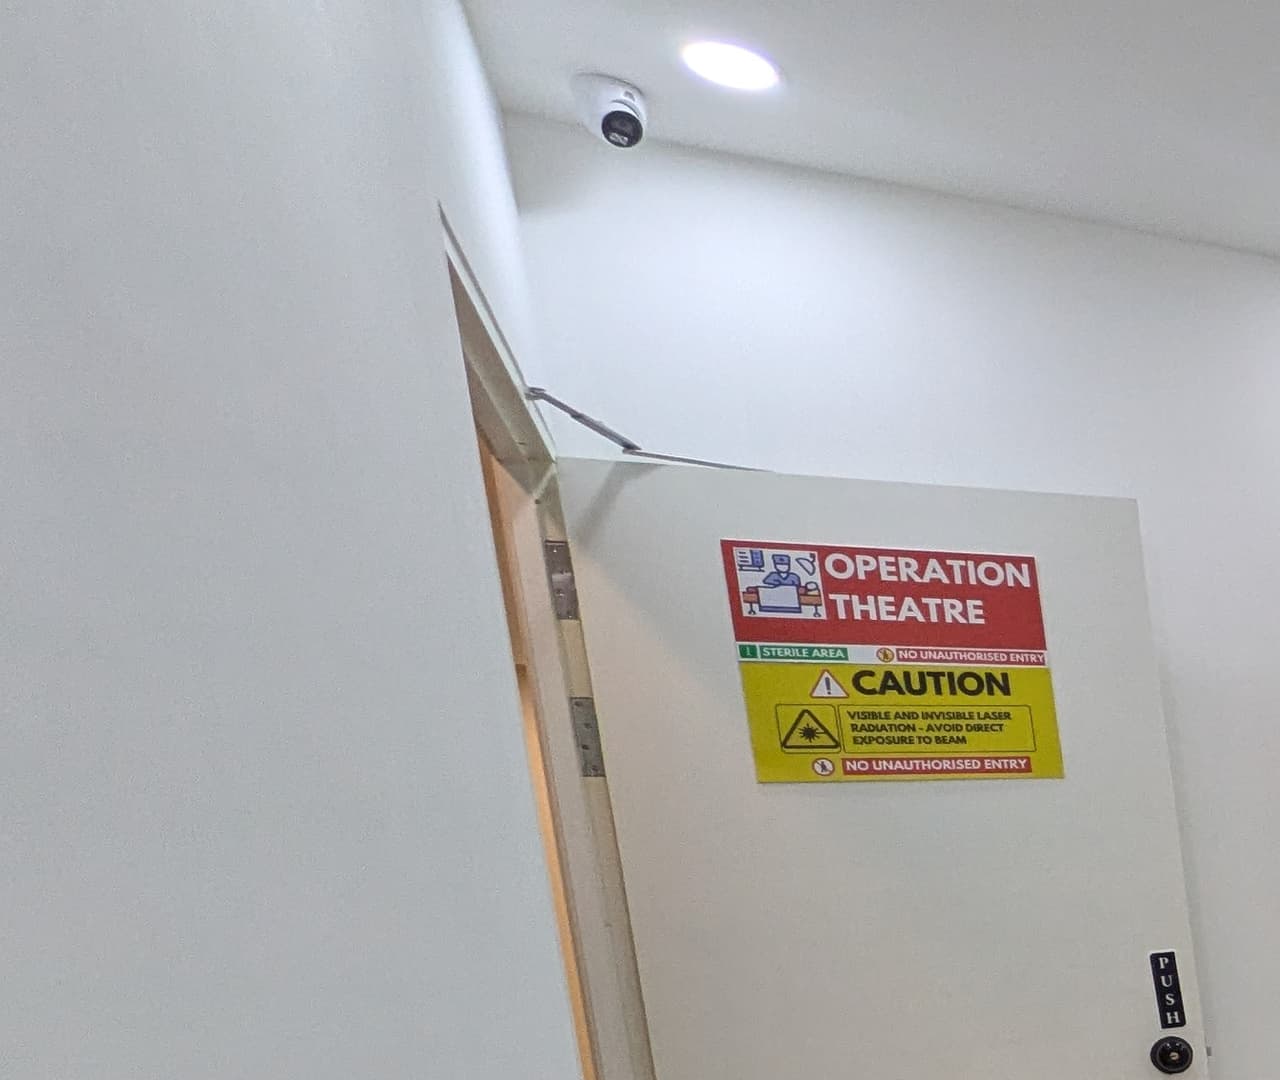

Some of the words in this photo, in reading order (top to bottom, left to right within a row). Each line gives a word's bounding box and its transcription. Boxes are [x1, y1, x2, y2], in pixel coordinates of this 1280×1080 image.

[824, 553, 1031, 588] OPERATION
[828, 593, 985, 625] THEATRE
[762, 647, 809, 657] STERILE
[815, 649, 845, 658] AREA
[899, 650, 917, 659] NO
[920, 651, 1008, 662] UNAUTHORISED
[1010, 653, 1044, 663] ENTRY
[852, 670, 1011, 696] CAUTION
[847, 710, 890, 720] VISIBLE
[894, 711, 919, 720] AND
[922, 711, 976, 720] INVISIBLE
[977, 711, 1012, 720] LASER
[851, 723, 916, 732] RADIATION
[926, 723, 963, 732] AVOID
[965, 723, 1004, 732] DIRECT
[853, 736, 915, 745] EXPOSURE
[916, 736, 934, 744] TO
[935, 736, 967, 744] BEAM
[845, 760, 868, 771] NO
[873, 759, 981, 770] UNAUTHORISED
[984, 758, 1028, 769] ENTRY
[1158, 957, 1180, 1024] PUSH
